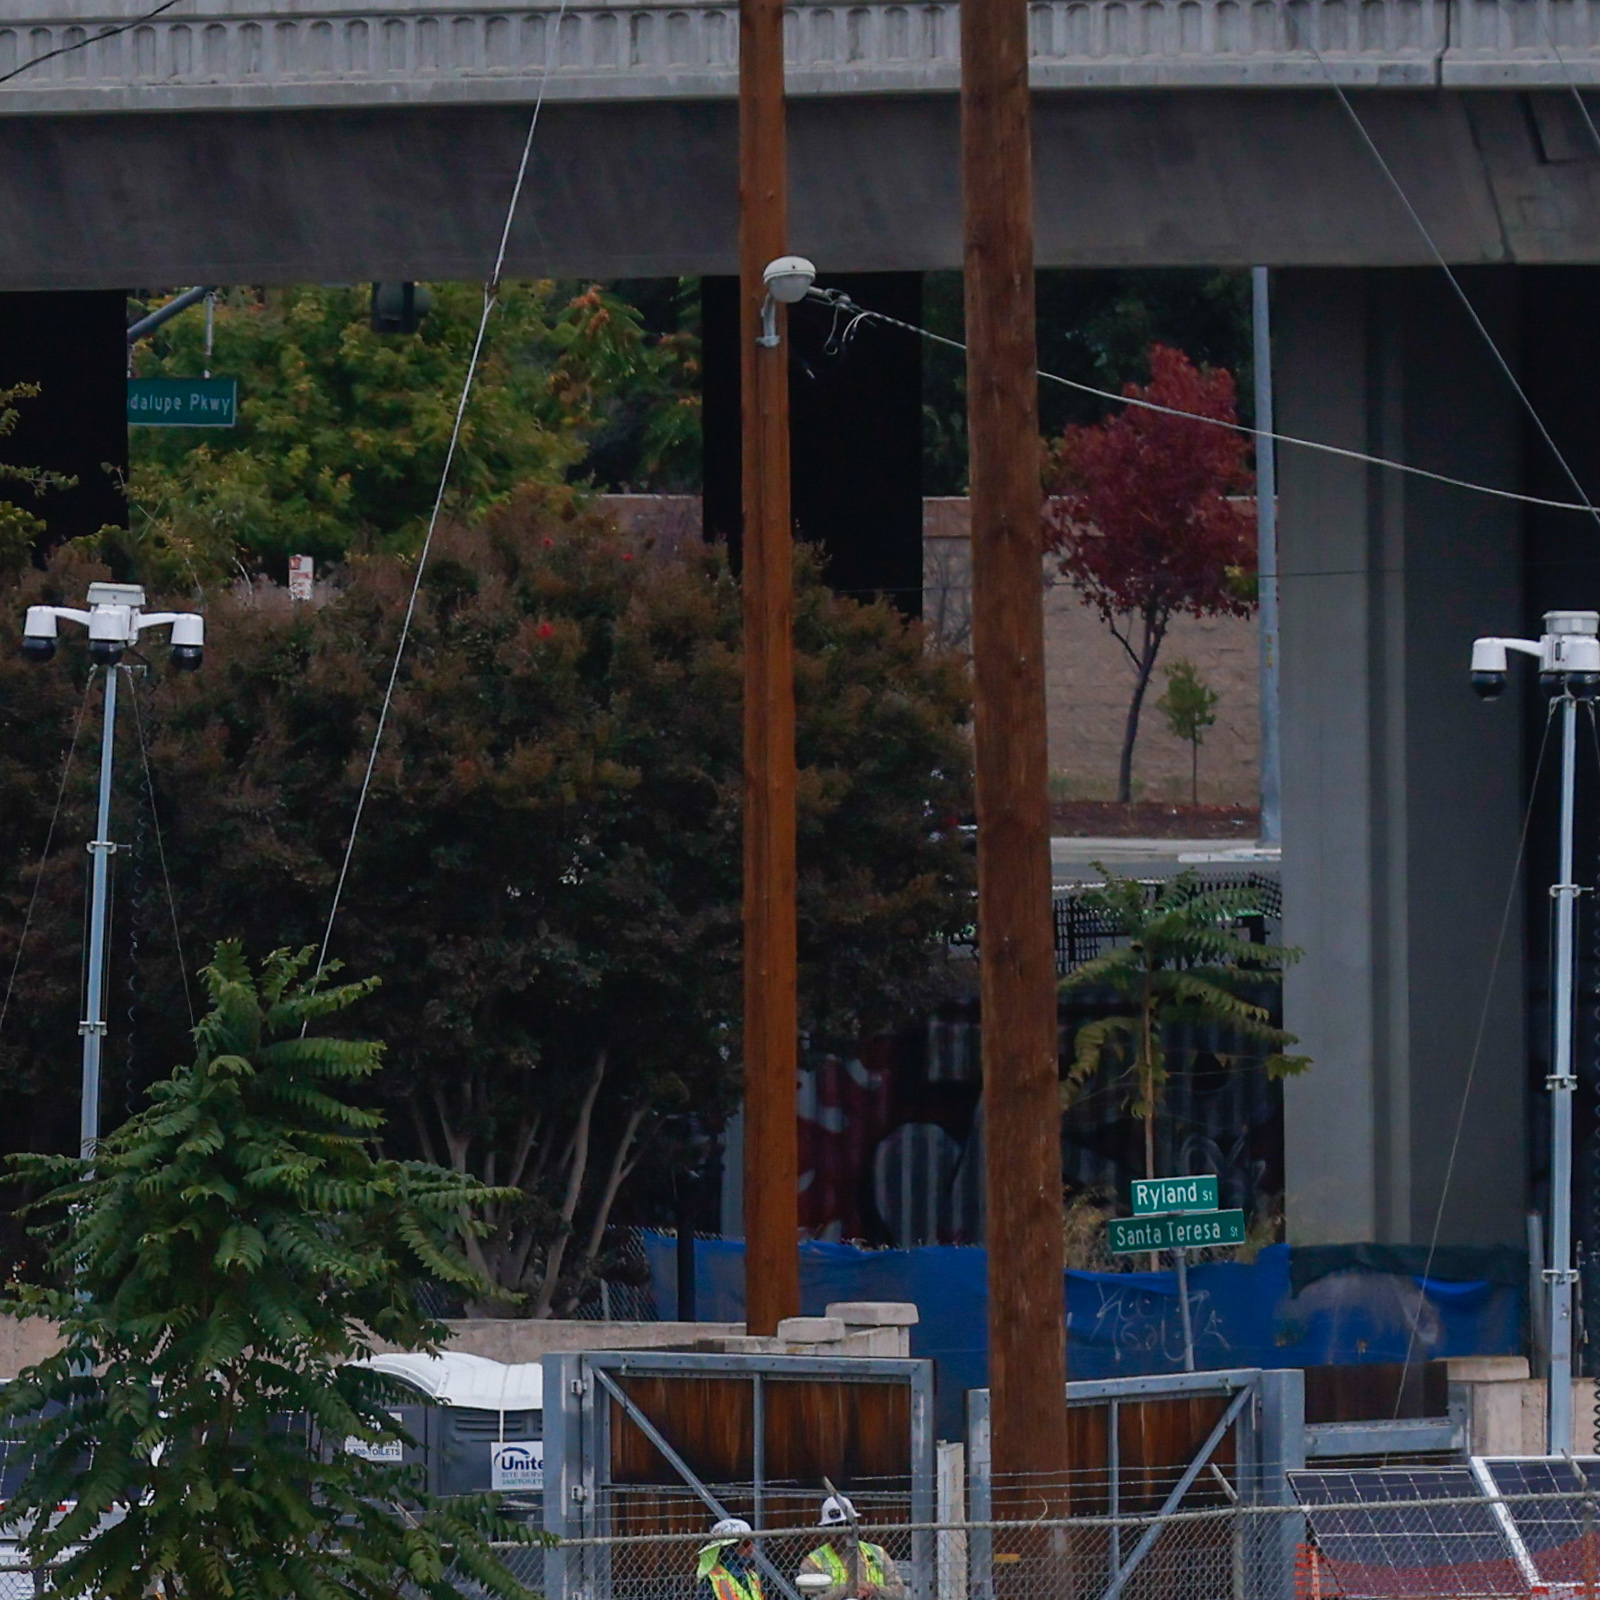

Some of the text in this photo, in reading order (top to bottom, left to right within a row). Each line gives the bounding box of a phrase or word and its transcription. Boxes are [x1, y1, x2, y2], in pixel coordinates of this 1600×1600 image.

[190, 393, 231, 416] Pkwy
[1136, 1182, 1213, 1210] Ryland St
[1116, 1224, 1162, 1247] Santa
[1166, 1221, 1221, 1242] Teresa
[501, 1455, 544, 1470] Unite
